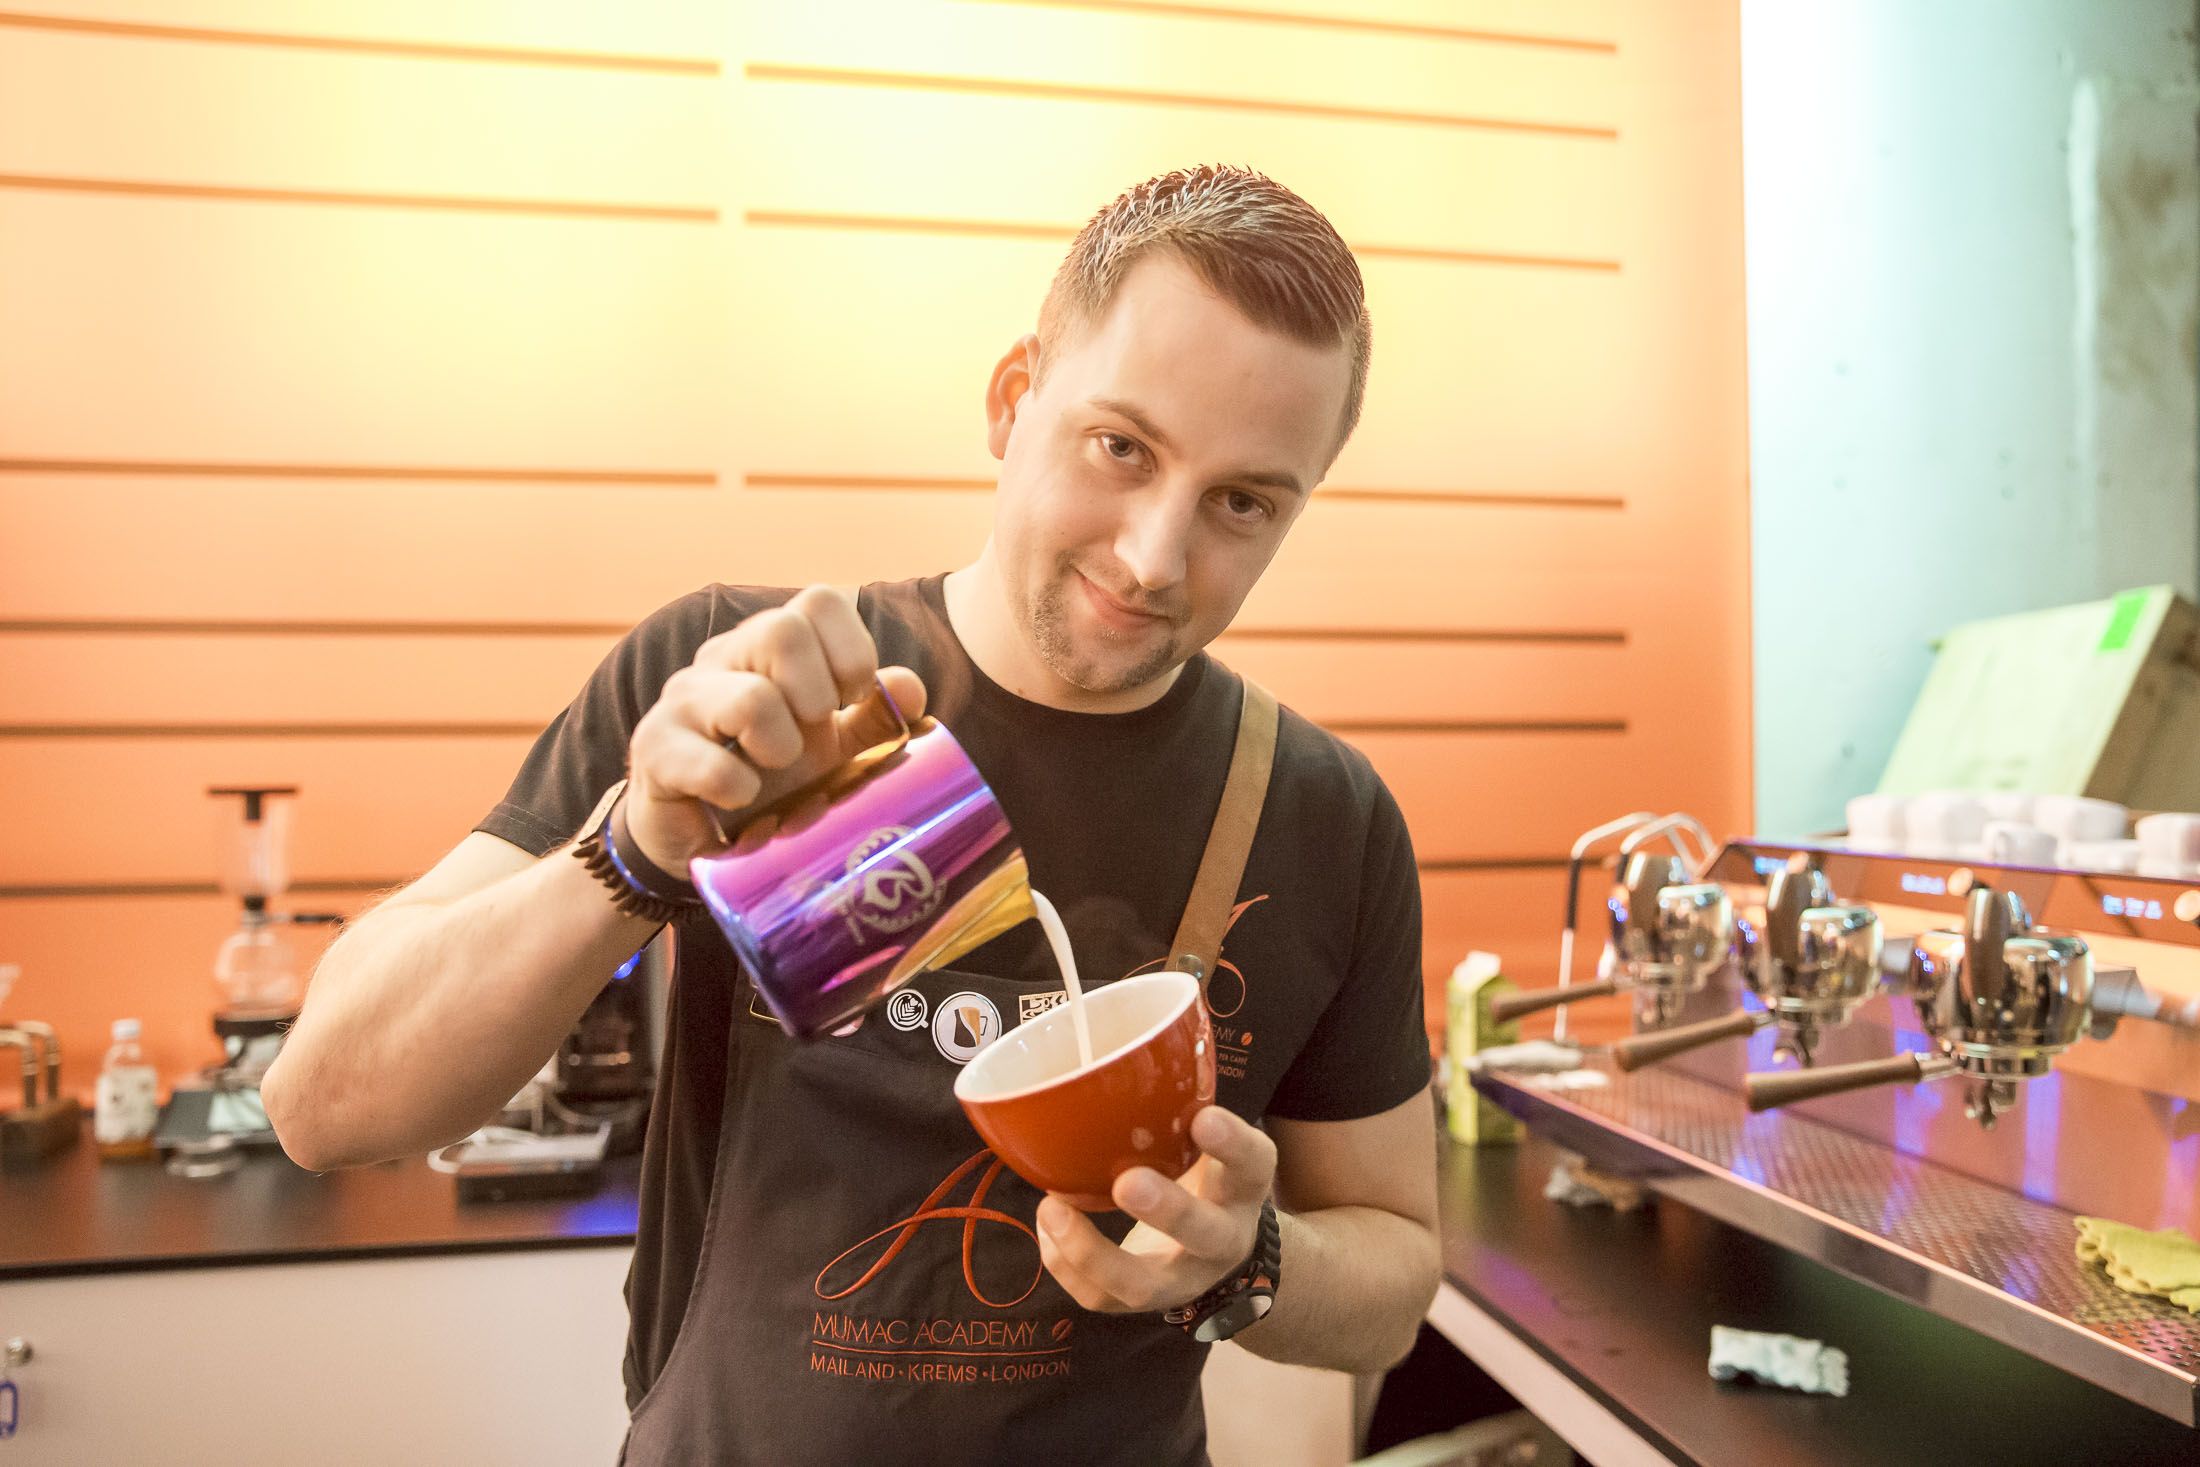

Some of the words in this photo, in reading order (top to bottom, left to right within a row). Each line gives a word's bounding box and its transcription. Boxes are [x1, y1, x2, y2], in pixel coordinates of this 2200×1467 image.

[813, 1311, 909, 1345] MUMAC
[913, 1319, 1040, 1347] ACADEMY
[810, 1352, 896, 1381] MAILAND
[907, 1361, 977, 1383] KREMS
[990, 1359, 1071, 1384] LONDON
